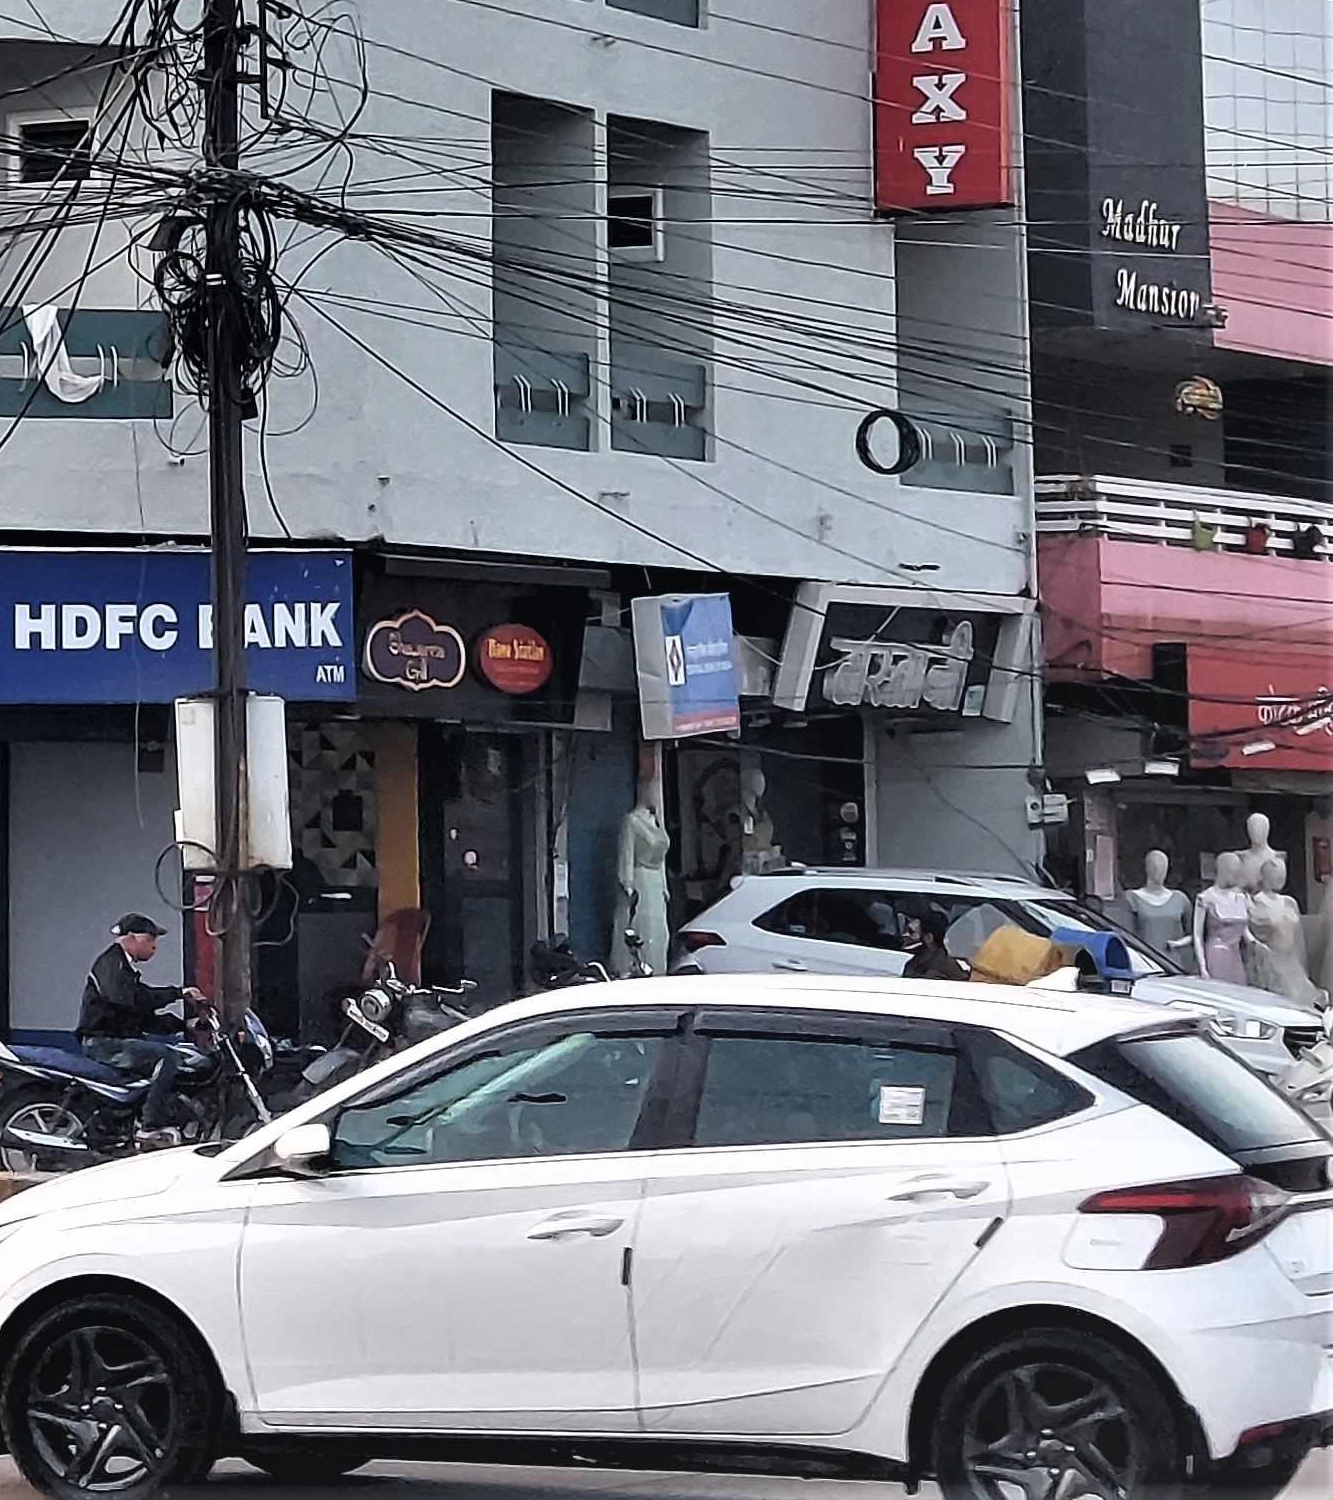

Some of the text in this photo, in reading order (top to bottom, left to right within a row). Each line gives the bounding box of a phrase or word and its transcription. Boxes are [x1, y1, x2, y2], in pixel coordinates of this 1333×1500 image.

[1101, 197, 1181, 251] Madhur
[13, 602, 178, 651] HDFC
[316, 664, 345, 684] ATM
